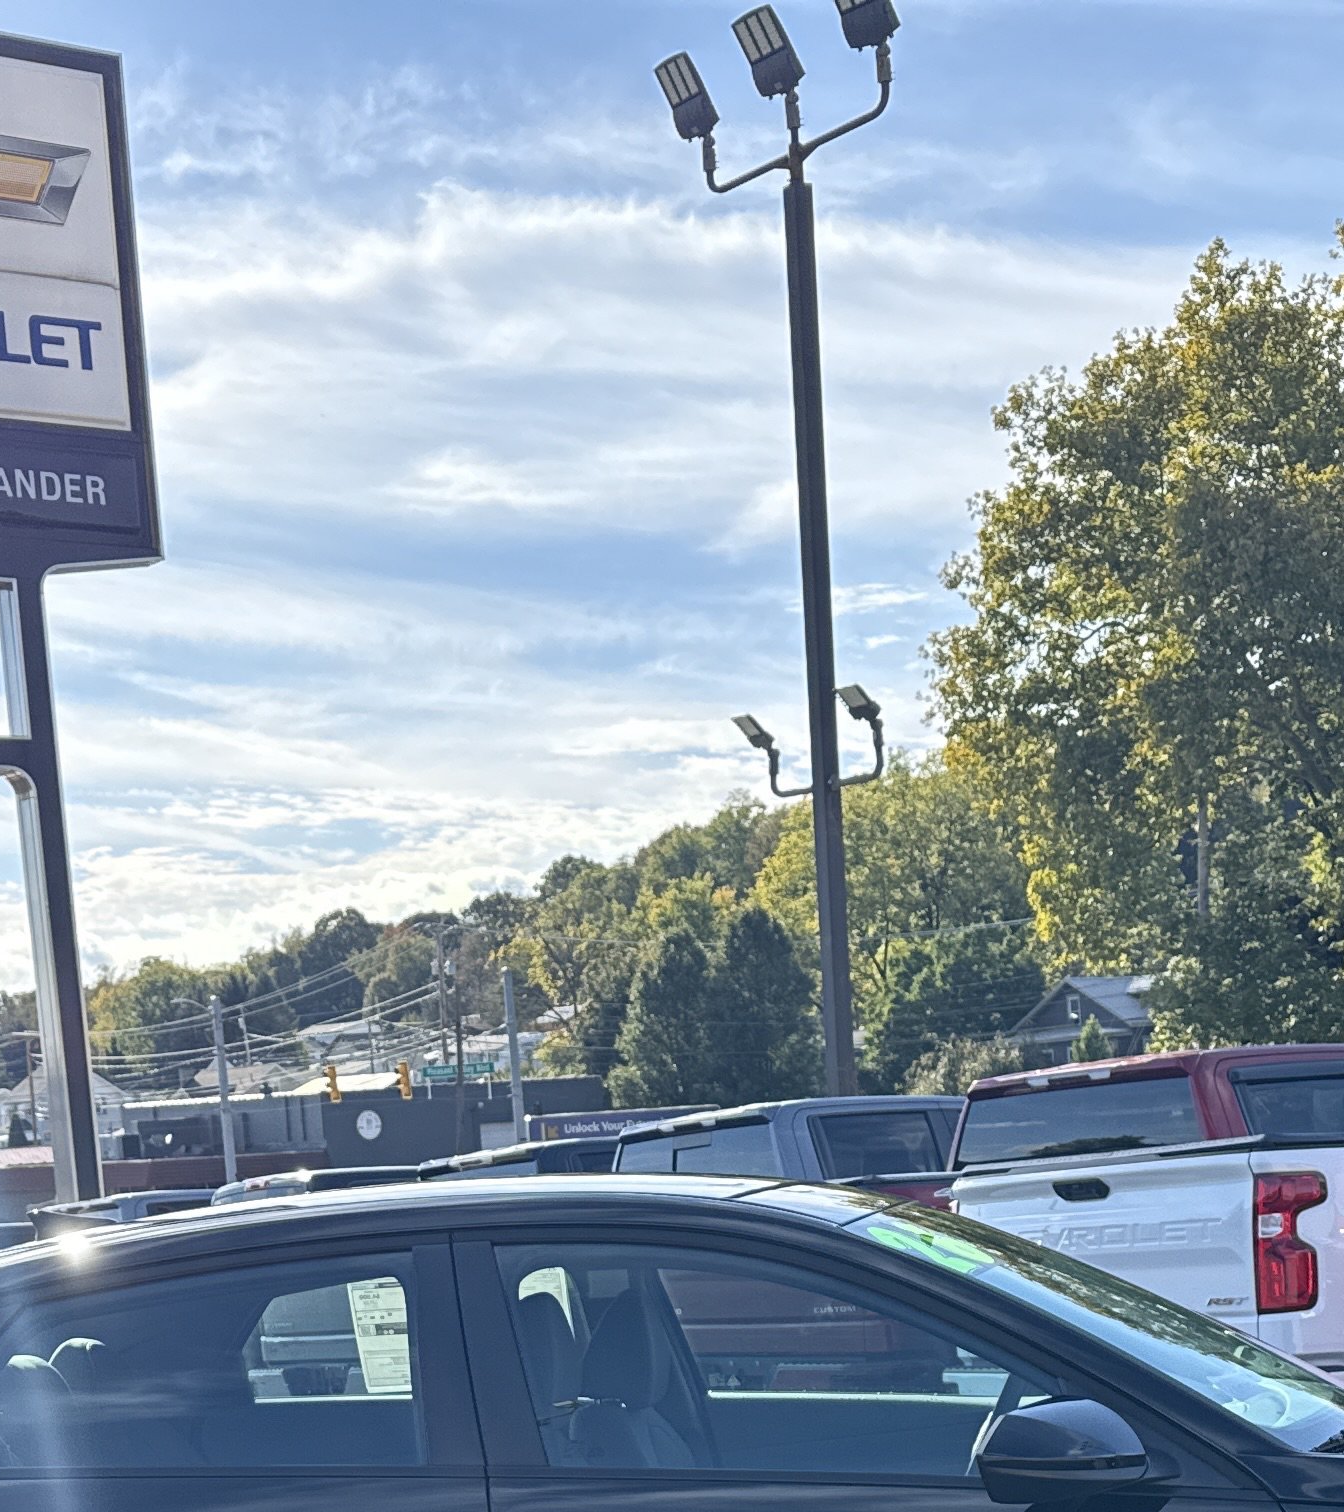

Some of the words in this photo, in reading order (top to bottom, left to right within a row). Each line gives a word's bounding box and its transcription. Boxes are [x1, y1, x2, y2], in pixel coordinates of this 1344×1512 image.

[564, 1121, 600, 1134] Unlock
[602, 1120, 624, 1132] Your
[1017, 1217, 1222, 1251] EVROLET
[1207, 1296, 1249, 1306] RST
[813, 1304, 856, 1314] CUSTOM
